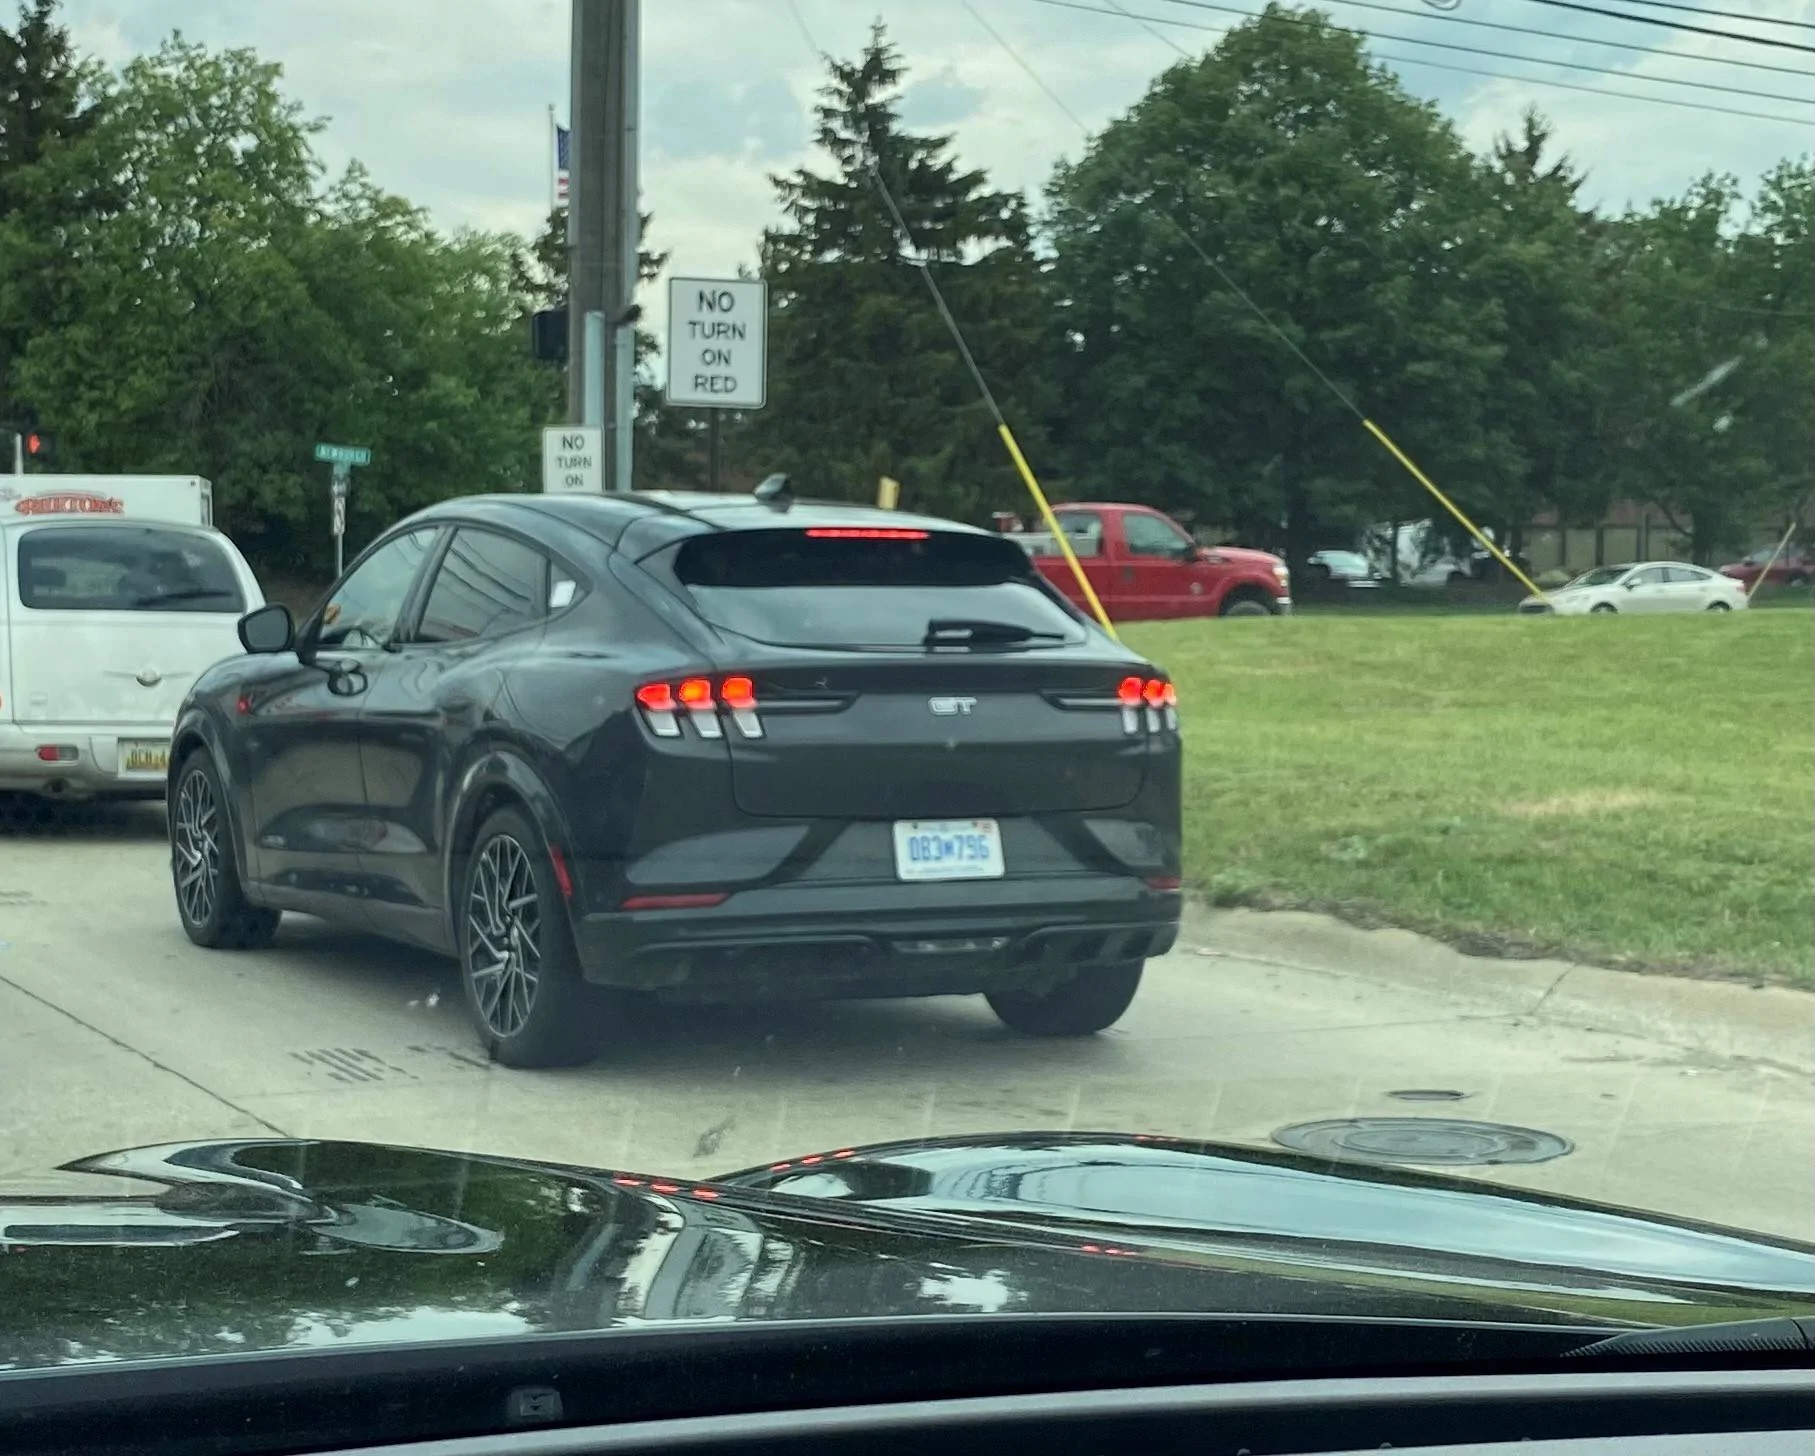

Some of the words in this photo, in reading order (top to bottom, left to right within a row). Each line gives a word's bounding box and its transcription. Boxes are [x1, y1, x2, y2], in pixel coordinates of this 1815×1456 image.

[698, 290, 735, 313] NO
[688, 321, 747, 341] TURN
[702, 348, 732, 366] ON
[694, 374, 738, 394] RED
[562, 435, 585, 450] NO
[557, 455, 592, 468] TURN
[565, 474, 584, 488] ON
[927, 696, 978, 716] GT
